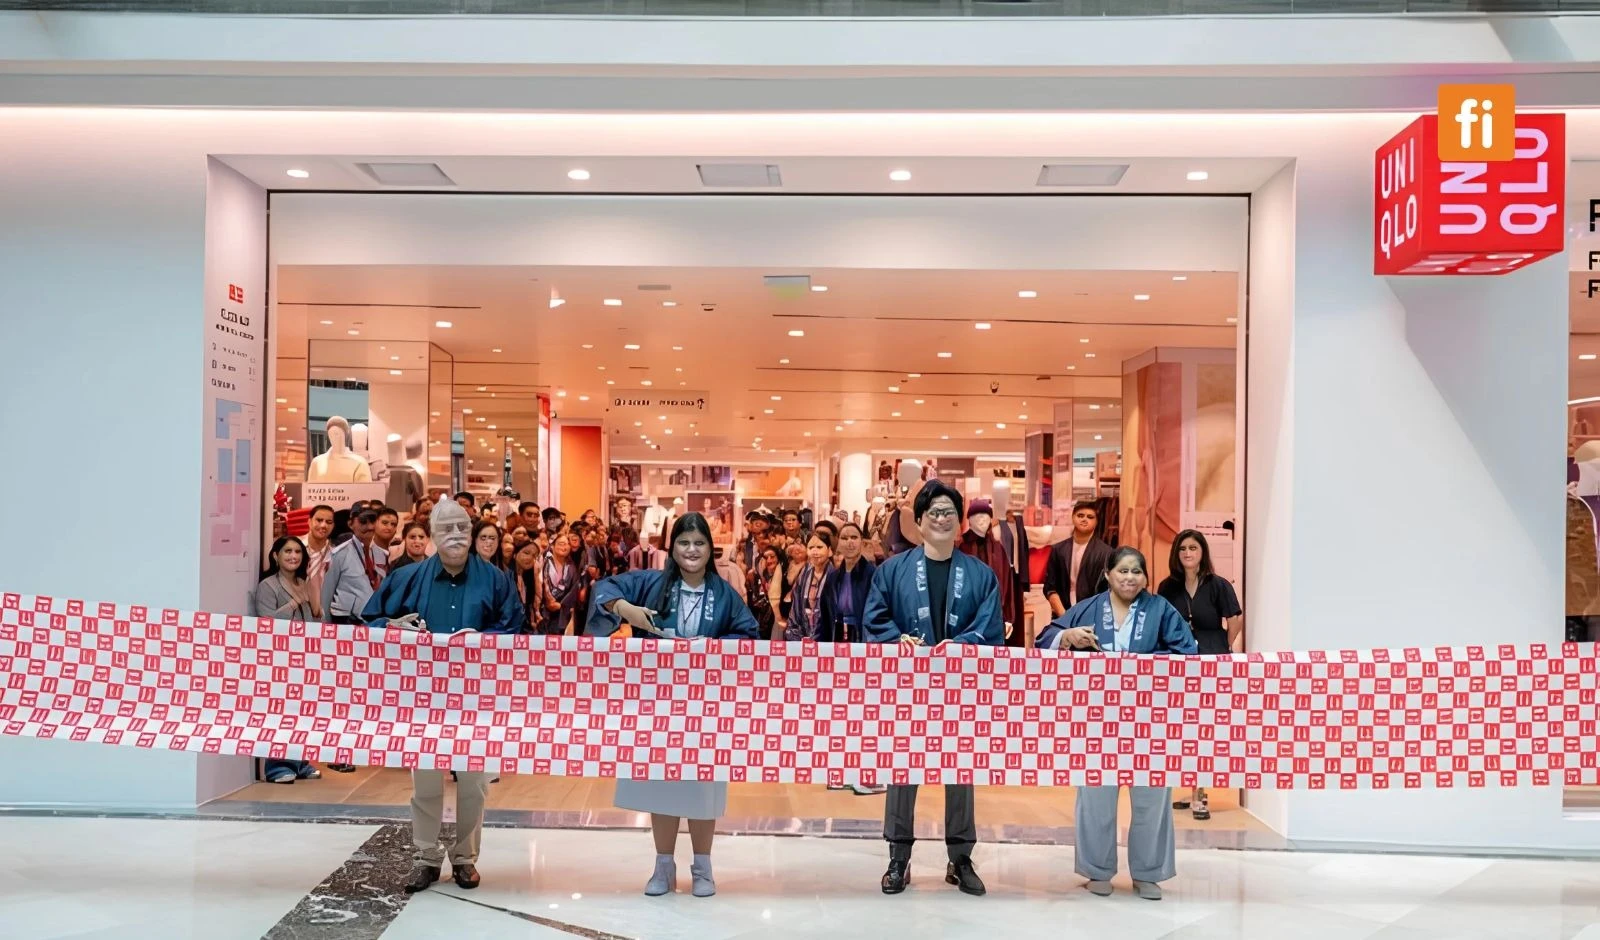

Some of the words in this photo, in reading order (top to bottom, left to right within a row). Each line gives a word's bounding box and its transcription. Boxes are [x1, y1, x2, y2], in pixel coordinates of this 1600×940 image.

[1381, 137, 1414, 200] UNI
[1439, 162, 1488, 235] UN
[1380, 194, 1418, 260] QLO
